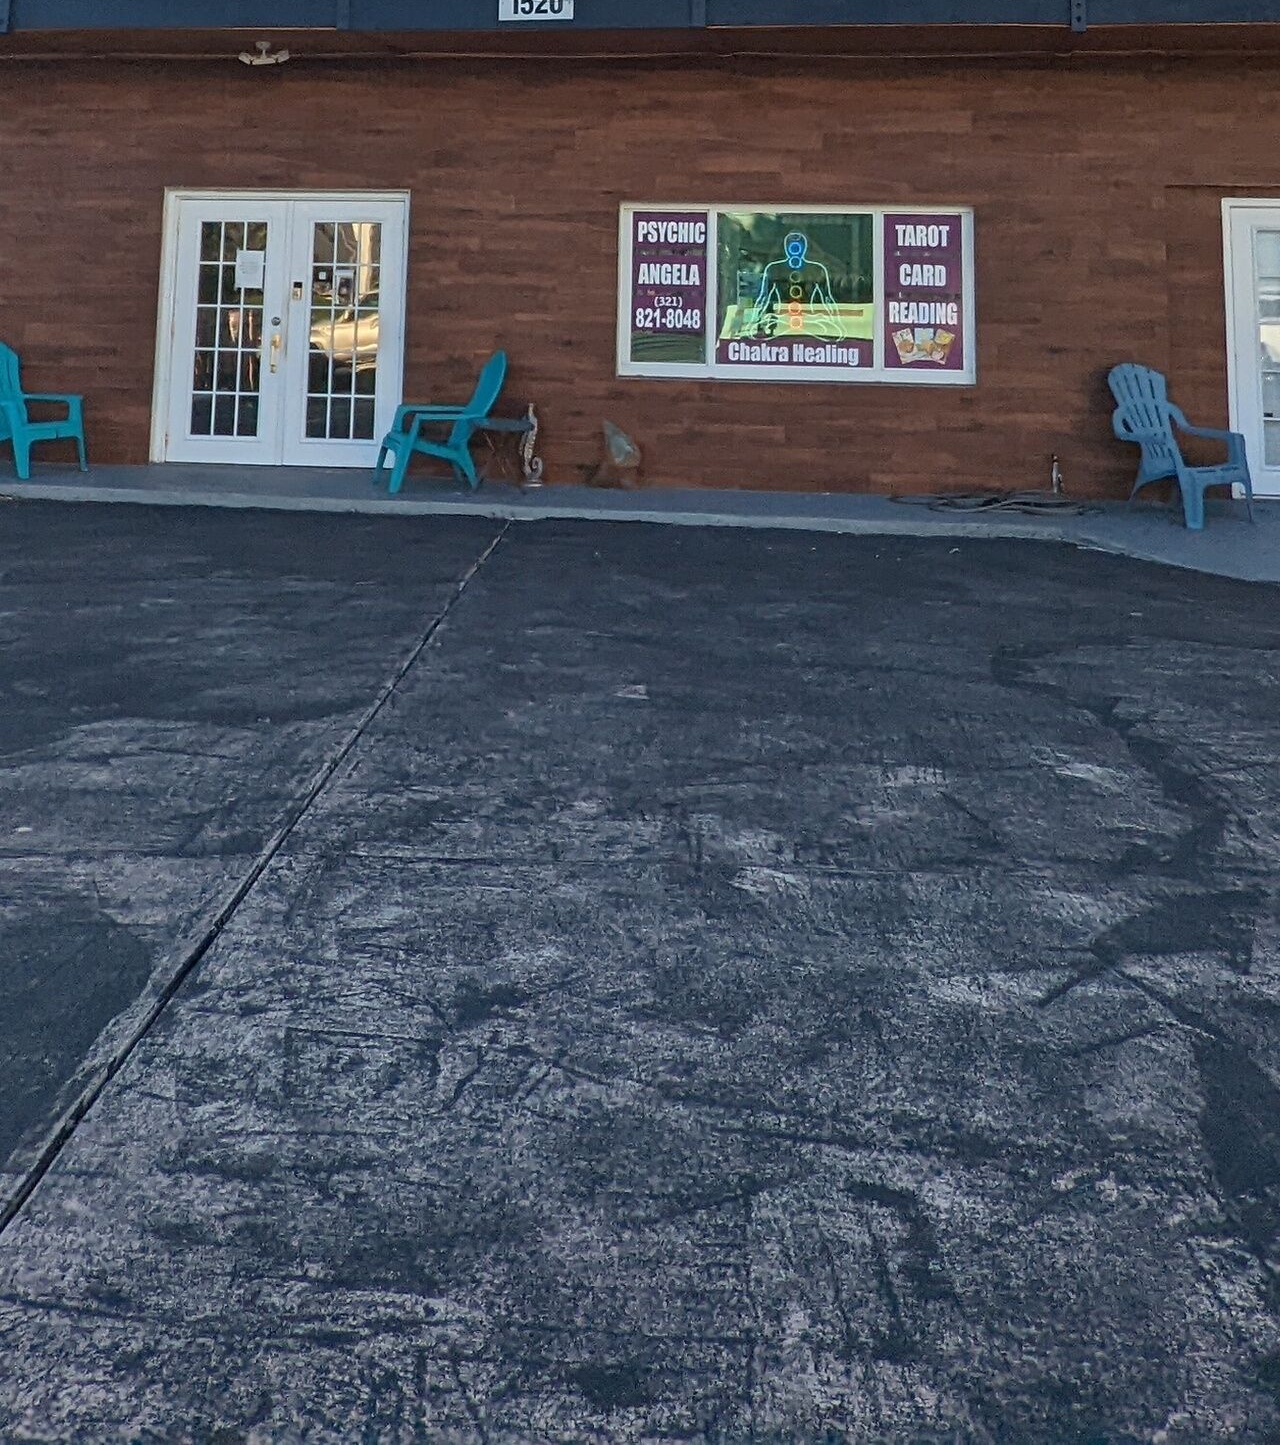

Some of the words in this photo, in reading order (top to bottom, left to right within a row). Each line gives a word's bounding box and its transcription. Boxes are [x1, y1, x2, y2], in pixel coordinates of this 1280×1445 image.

[637, 220, 706, 244] PSYCHIC
[894, 224, 950, 248] TAROT
[637, 262, 701, 286] ANGELA
[899, 263, 947, 287] CARD
[653, 296, 683, 308] (321)
[888, 301, 959, 326] READING
[635, 307, 701, 329] 821-8048
[728, 341, 790, 362] Chakra
[792, 343, 859, 366] Healing
